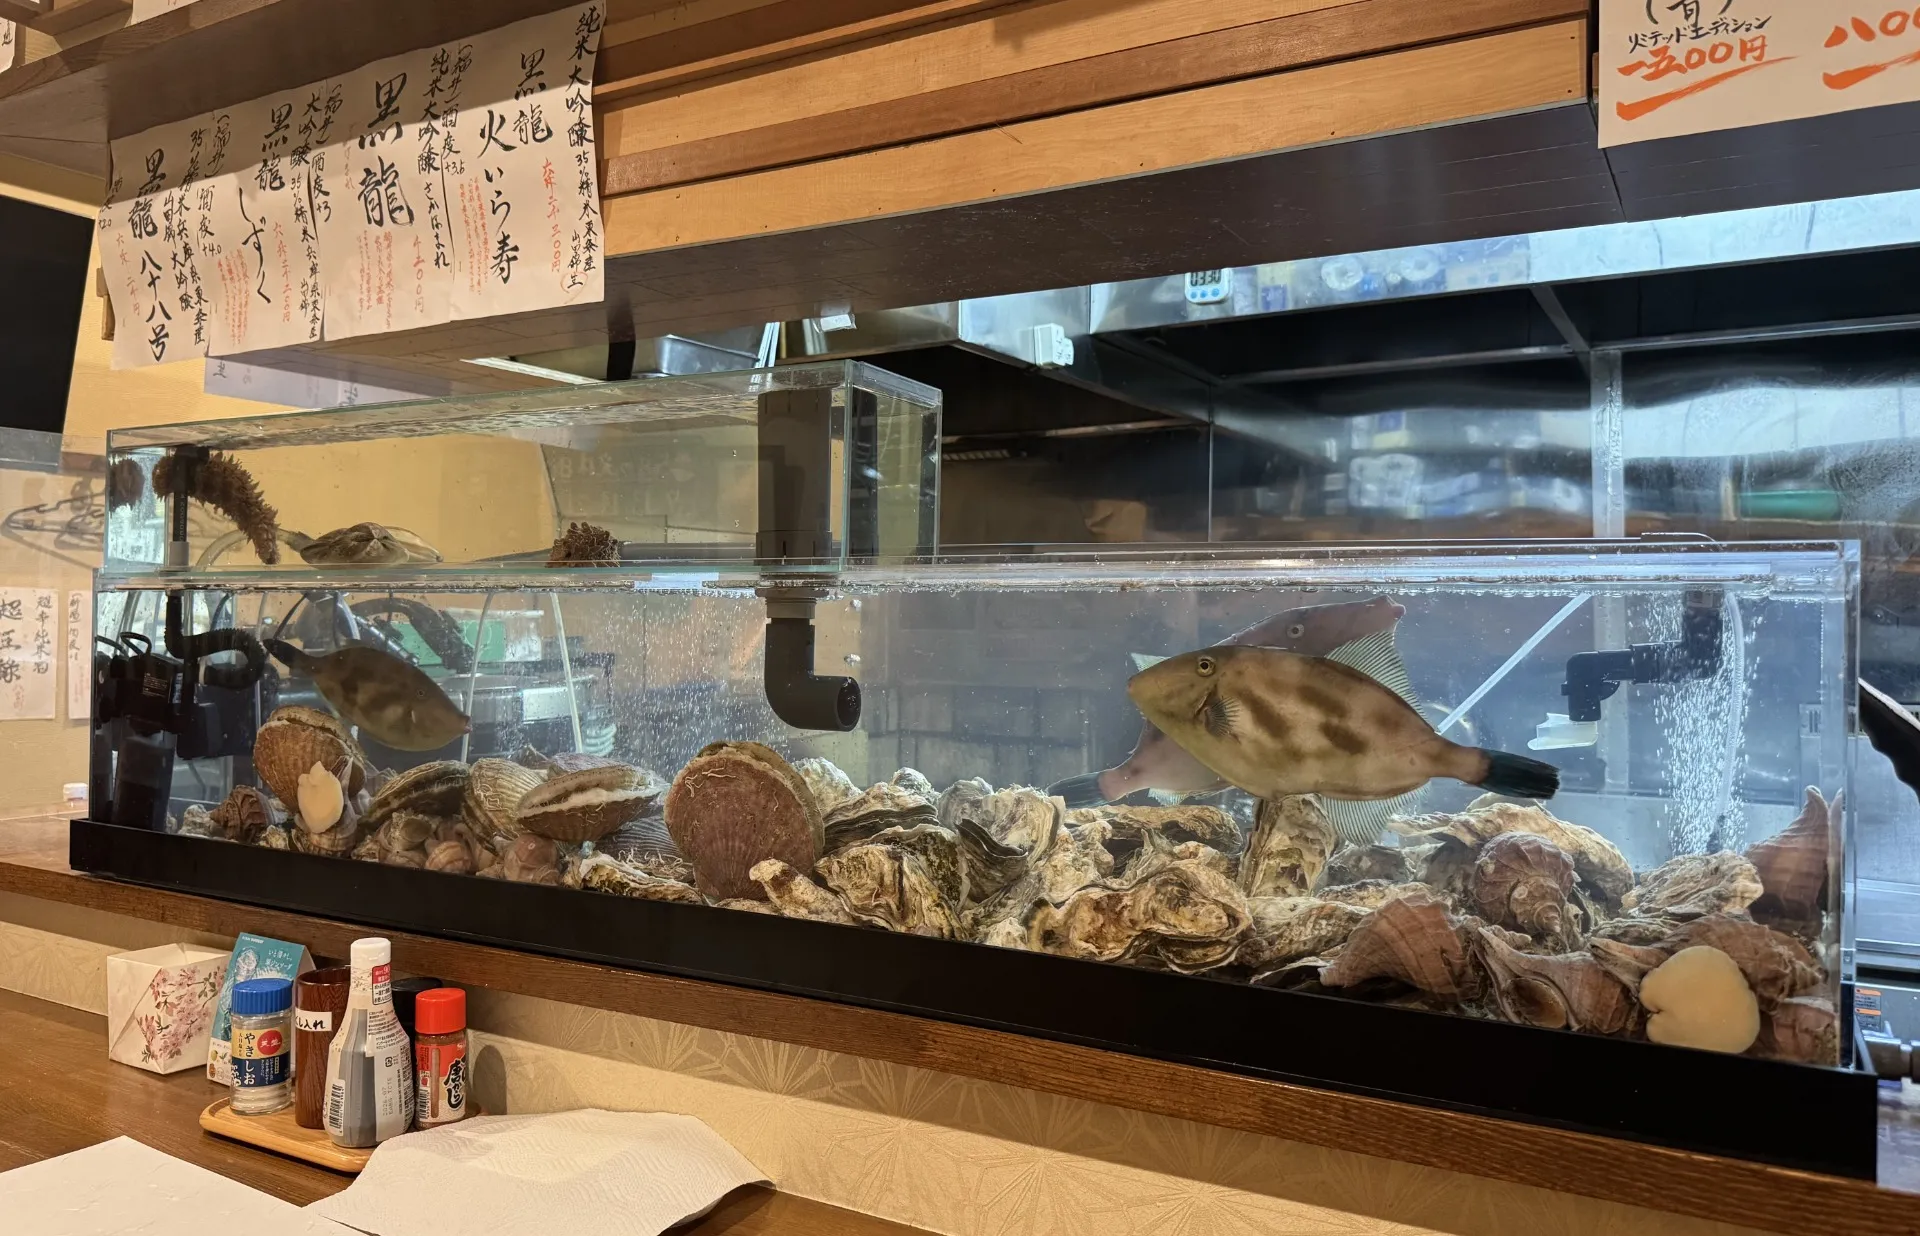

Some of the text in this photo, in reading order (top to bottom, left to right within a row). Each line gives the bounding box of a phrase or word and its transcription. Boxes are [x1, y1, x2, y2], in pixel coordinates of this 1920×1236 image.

[1628, 16, 1772, 53] リミテッドエディション
[512, 48, 554, 147] 黒龍
[253, 102, 293, 192] 黒龍
[357, 72, 416, 228] 黒龍
[477, 108, 519, 285] 火いら寿
[243, 1032, 256, 1086] やきしお
